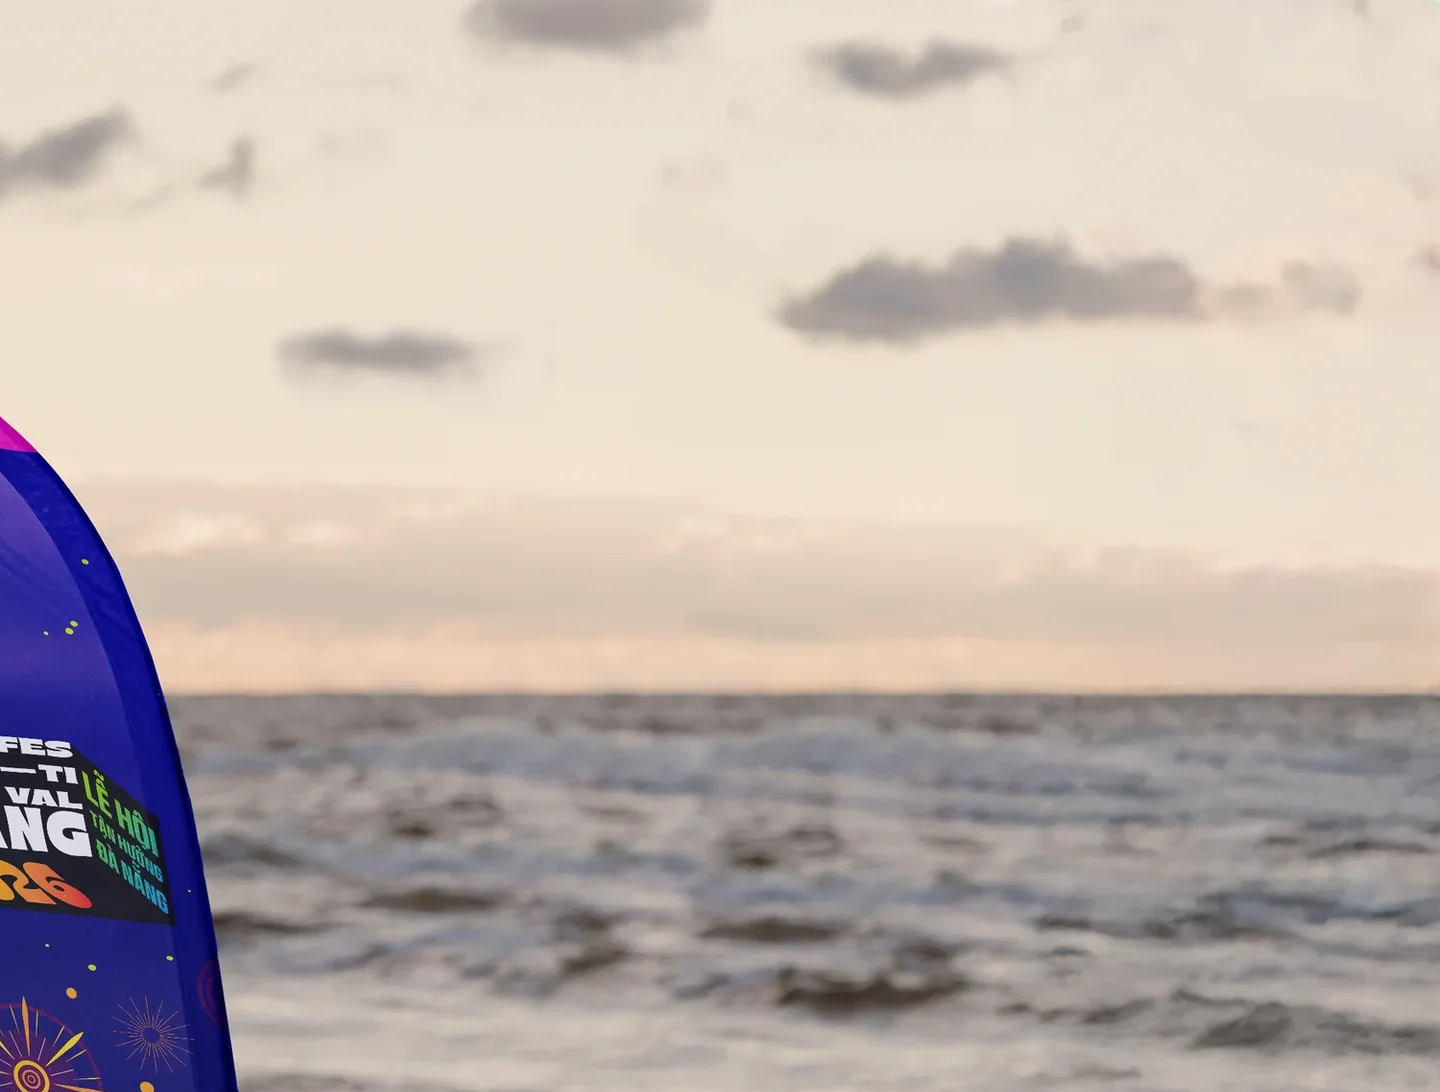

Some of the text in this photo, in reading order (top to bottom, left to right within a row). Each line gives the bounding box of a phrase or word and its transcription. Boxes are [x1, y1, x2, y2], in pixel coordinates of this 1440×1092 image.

[4, 786, 83, 809] VAL
[81, 769, 159, 858] LỄ HỘI
[96, 838, 169, 914] ĐÀ NẴNG
